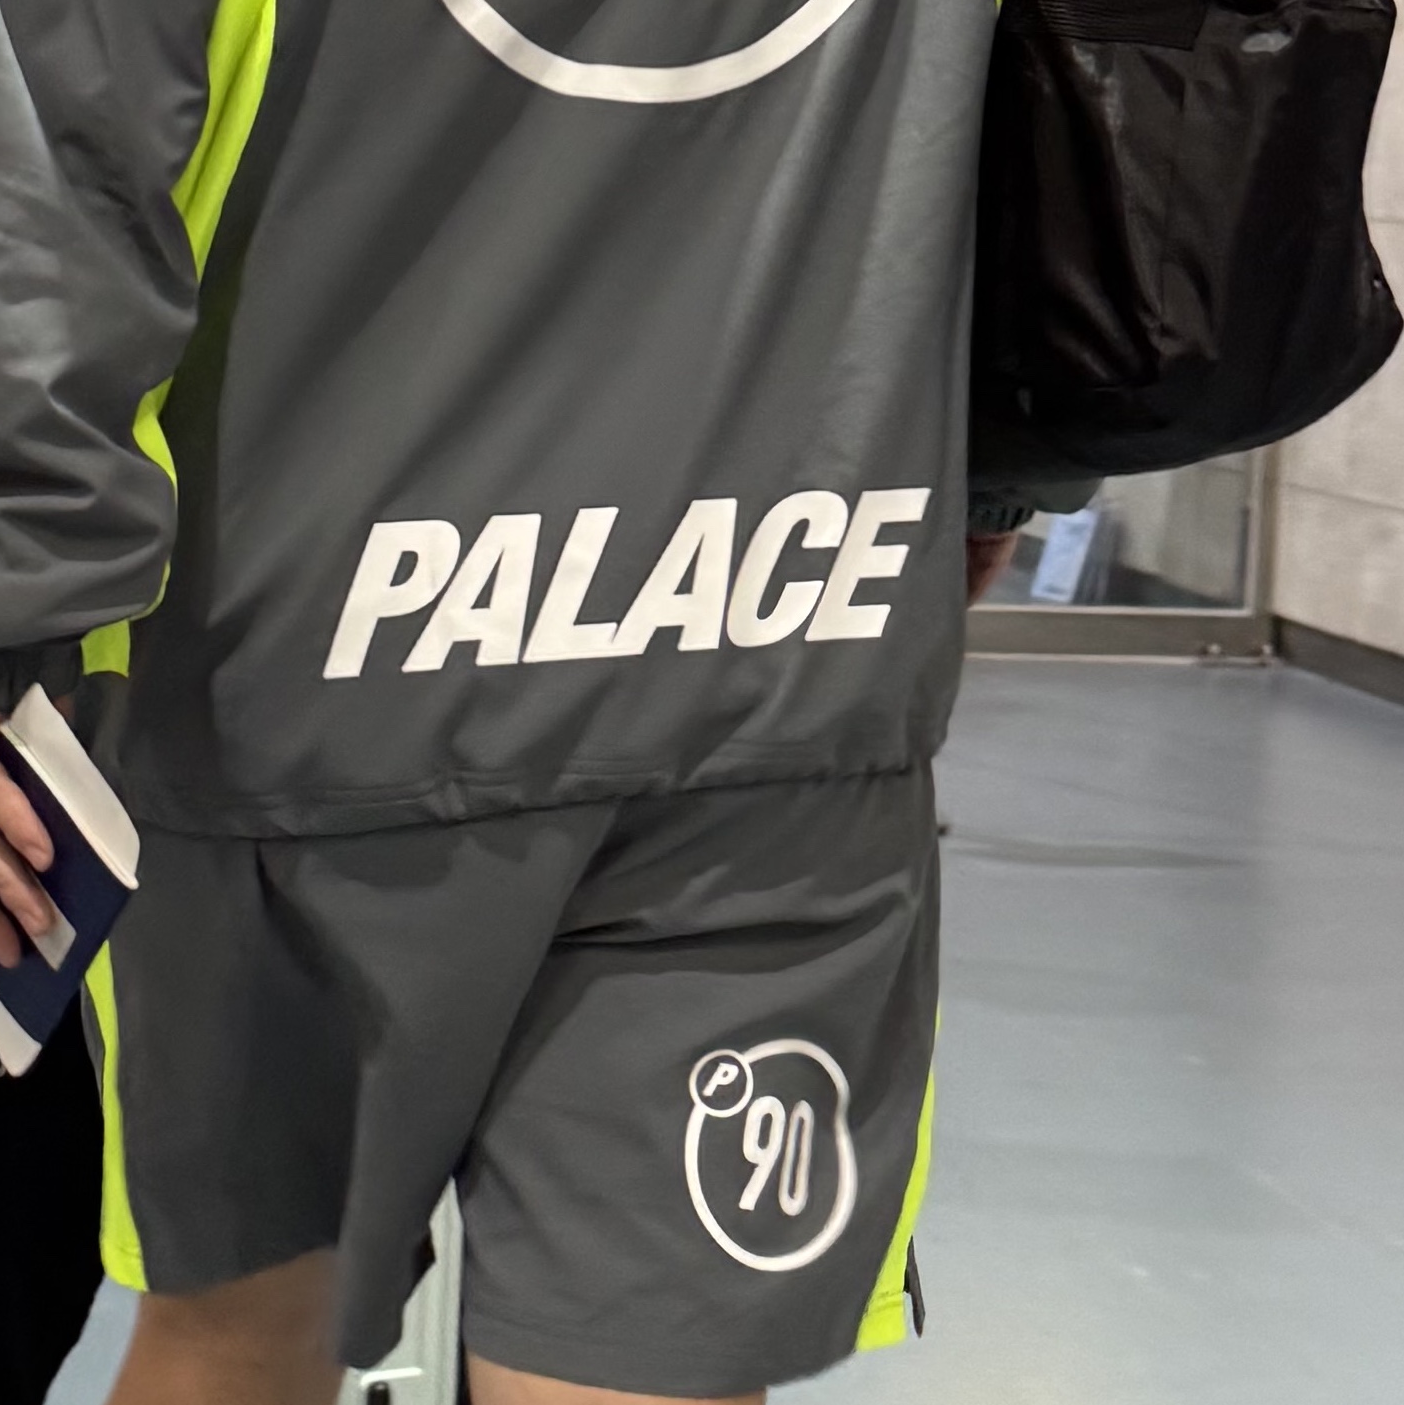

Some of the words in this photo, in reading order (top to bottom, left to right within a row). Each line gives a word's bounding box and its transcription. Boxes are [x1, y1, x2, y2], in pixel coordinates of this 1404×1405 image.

[323, 487, 932, 679] PALACE
[702, 1062, 739, 1096] P
[738, 1095, 814, 1216] 90
